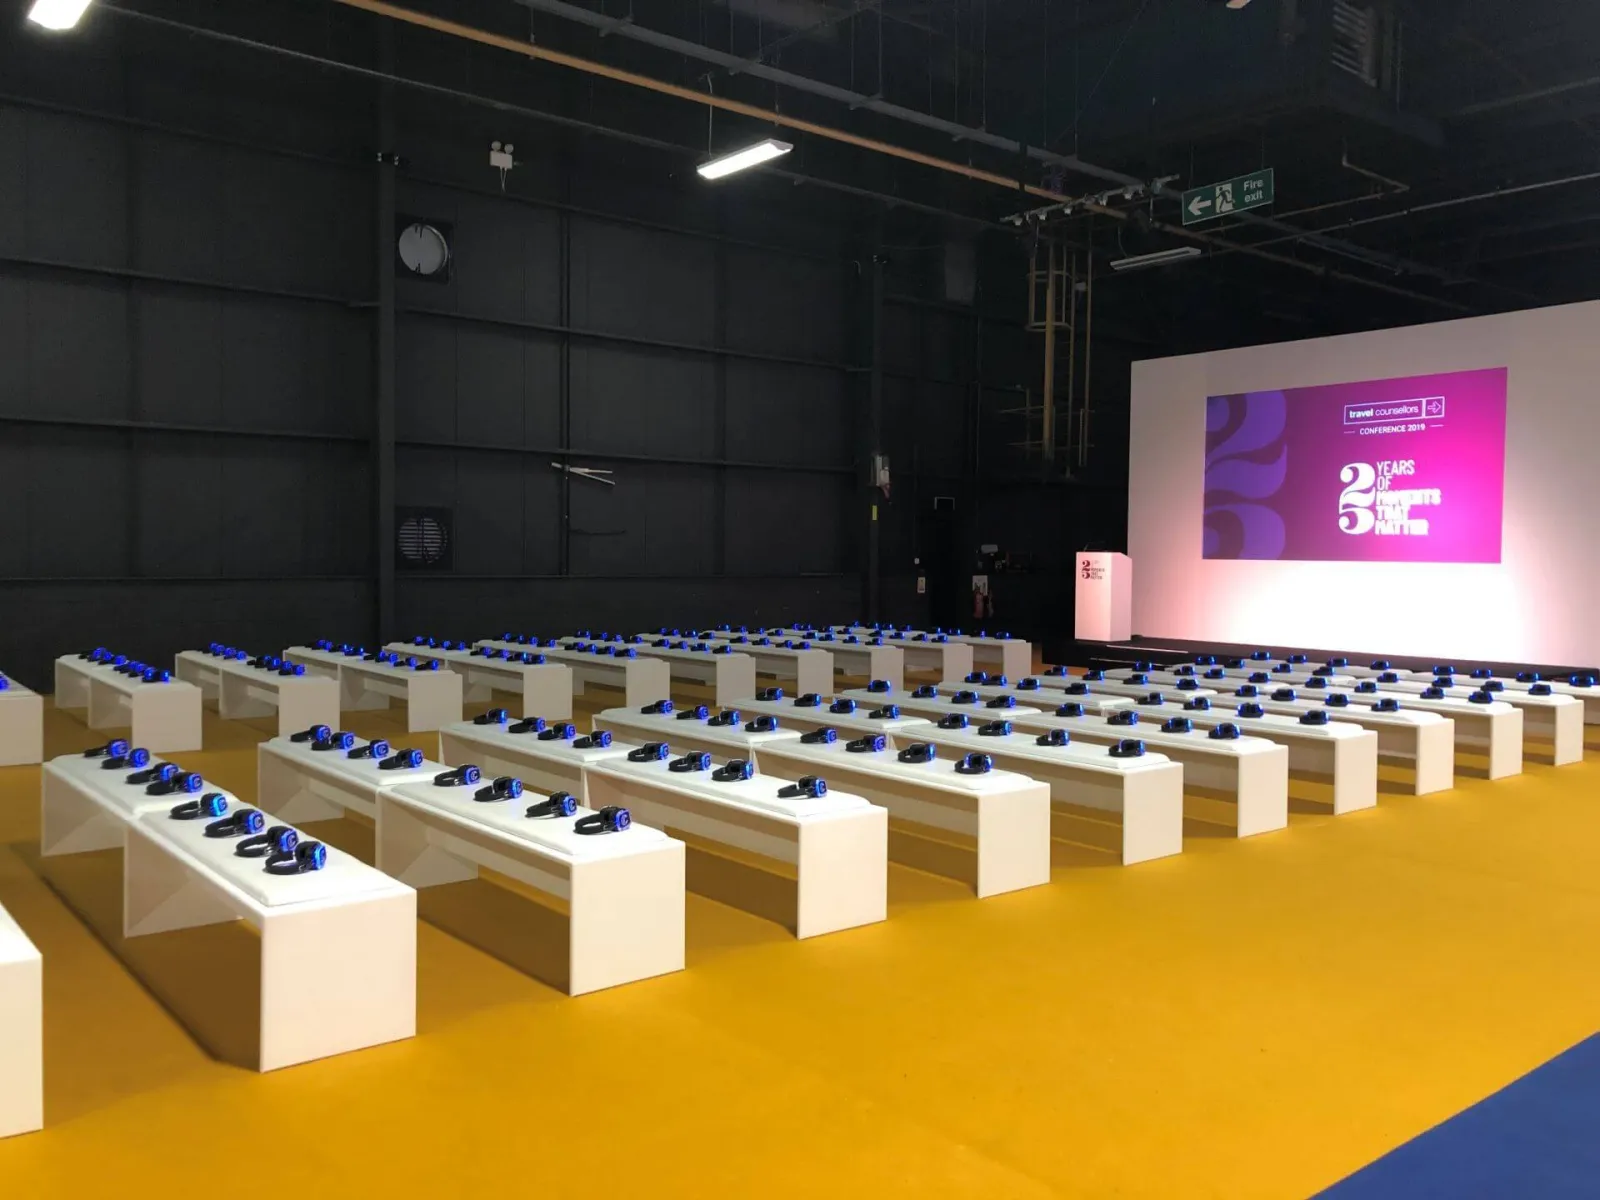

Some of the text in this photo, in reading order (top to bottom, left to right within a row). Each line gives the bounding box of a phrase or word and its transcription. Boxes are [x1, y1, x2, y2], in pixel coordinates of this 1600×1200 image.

[1244, 180, 1263, 191] Fire
[1244, 190, 1263, 202] exit
[1349, 405, 1419, 418] travel counsellors
[1359, 424, 1425, 435] CONFERENCE 2019
[1376, 460, 1415, 476] YEARS
[1377, 476, 1392, 490] OF
